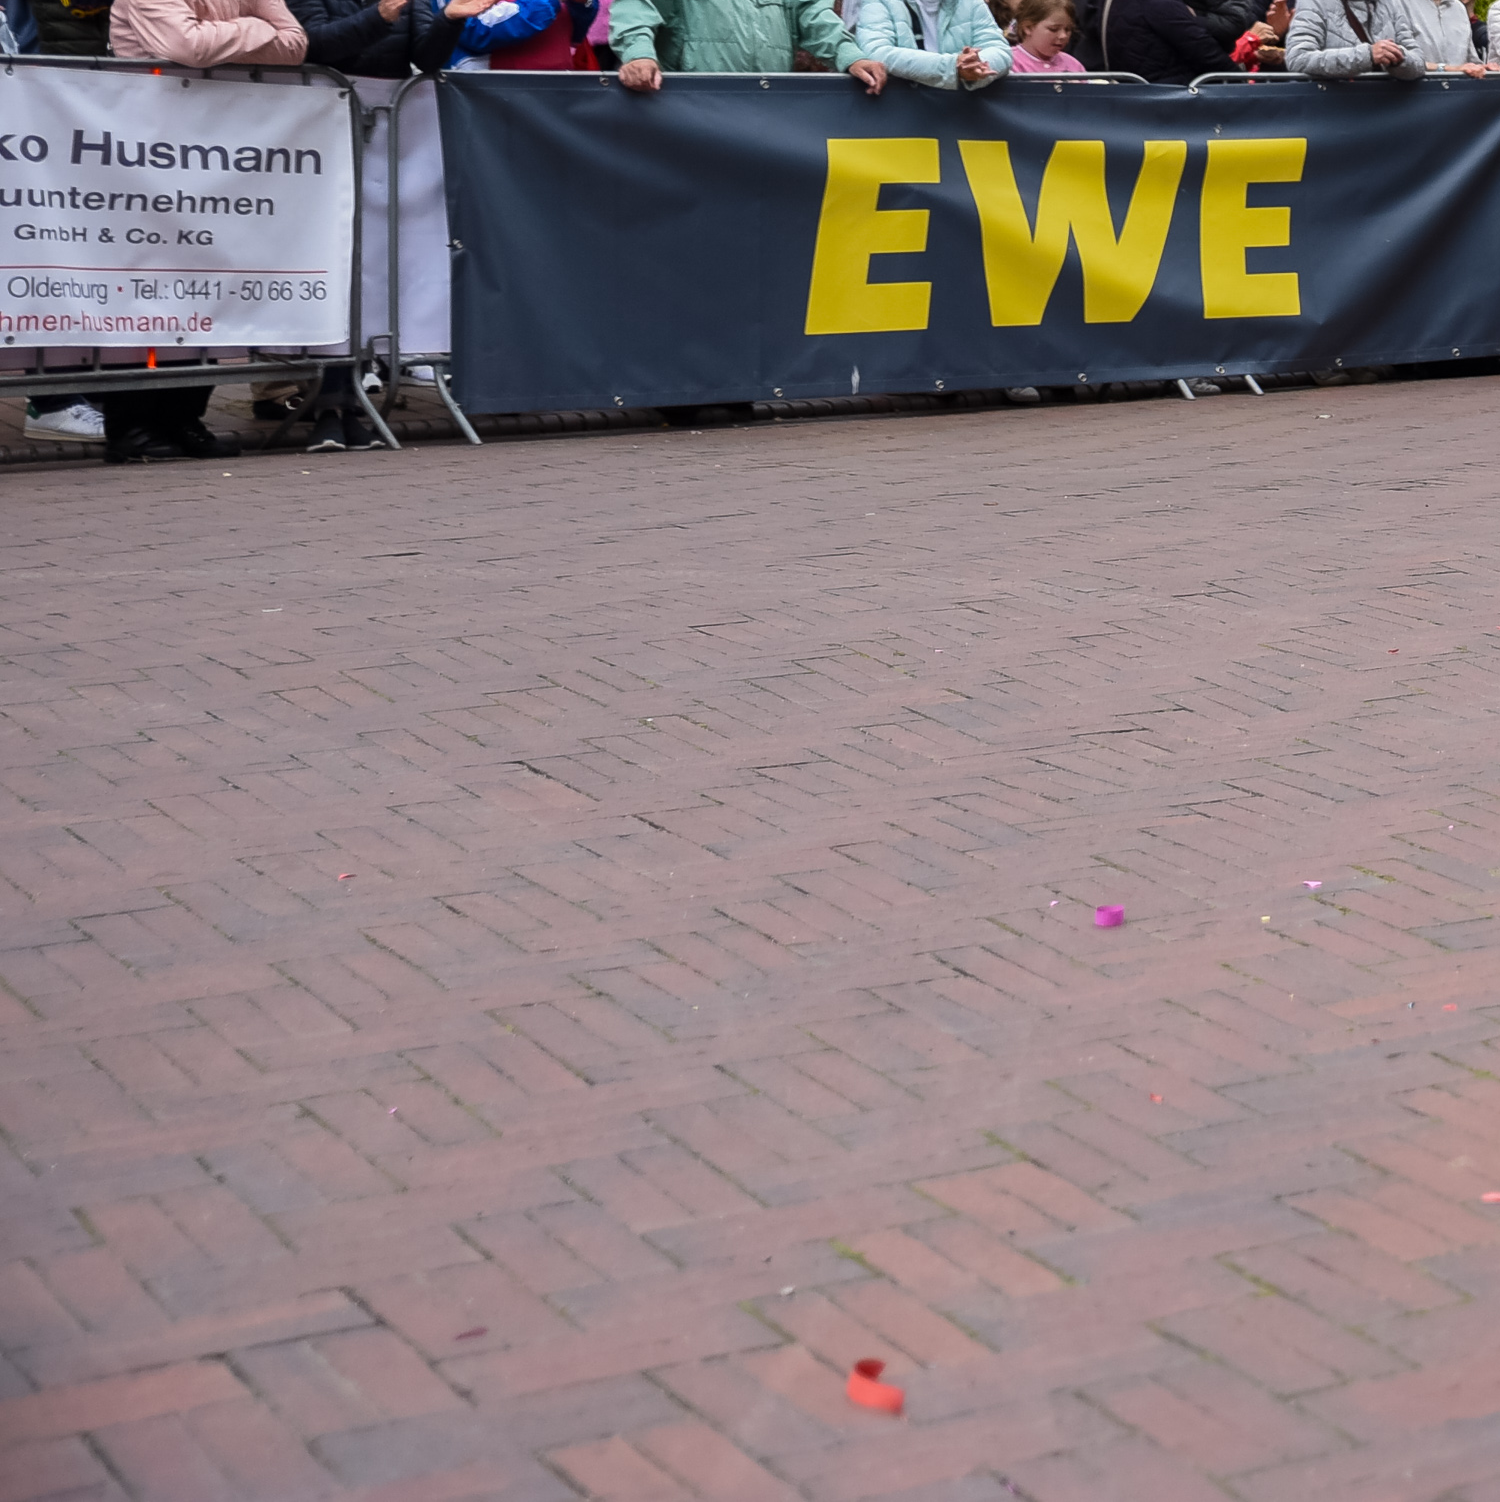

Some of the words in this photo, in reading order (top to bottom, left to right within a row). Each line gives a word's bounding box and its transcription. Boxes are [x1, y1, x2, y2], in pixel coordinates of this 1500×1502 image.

[71, 129, 322, 174] Husmann
[0, 187, 274, 215] uunternehmen
[14, 224, 87, 242] GmbH
[98, 225, 115, 243] &
[126, 228, 167, 244] Co.
[177, 229, 214, 246] KG
[804, 138, 1307, 335] EWE
[8, 276, 108, 304] Oldenburg
[130, 279, 168, 300] Tel.:
[173, 280, 222, 300] 0441
[240, 281, 263, 300] 50
[268, 281, 293, 300] 66
[299, 281, 327, 301] 36
[0, 310, 212, 333] hmen-husmann.de
